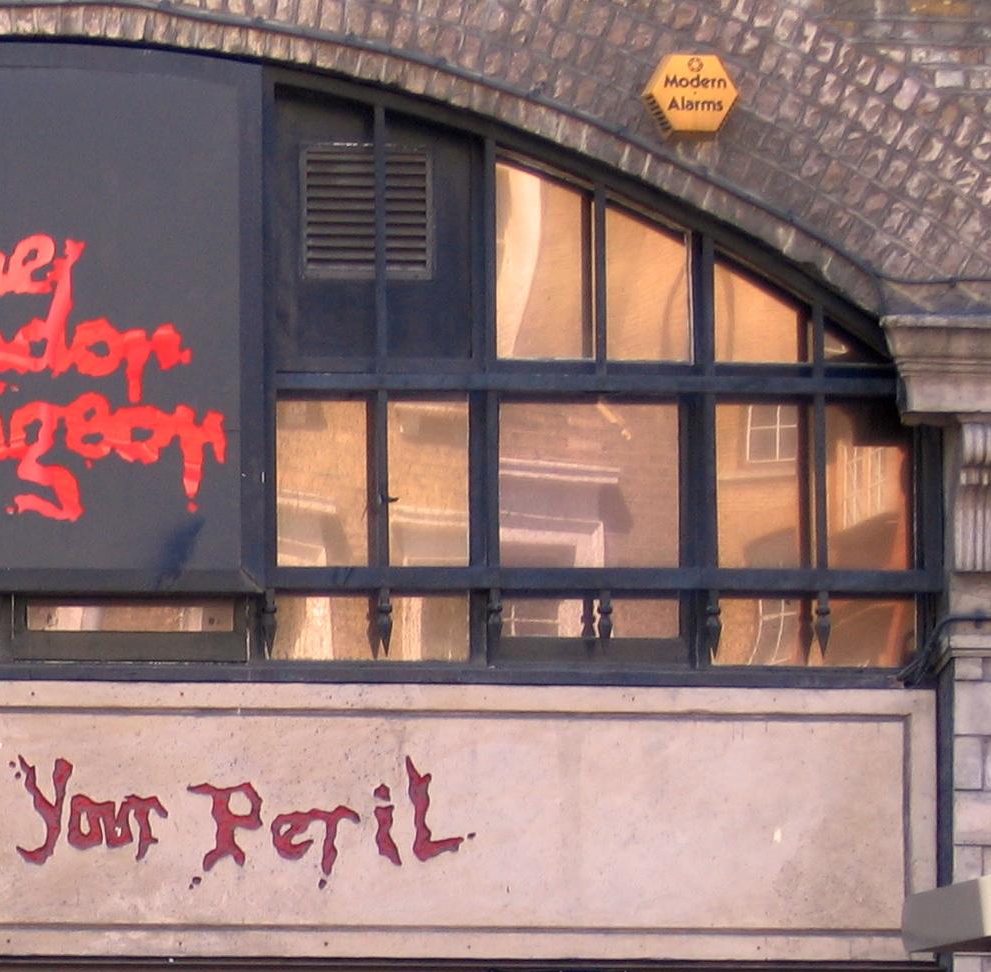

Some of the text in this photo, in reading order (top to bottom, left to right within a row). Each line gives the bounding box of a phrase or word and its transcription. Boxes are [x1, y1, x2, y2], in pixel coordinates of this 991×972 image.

[664, 74, 728, 89] Modern
[667, 96, 724, 111] Alarms
[15, 754, 168, 866] Your
